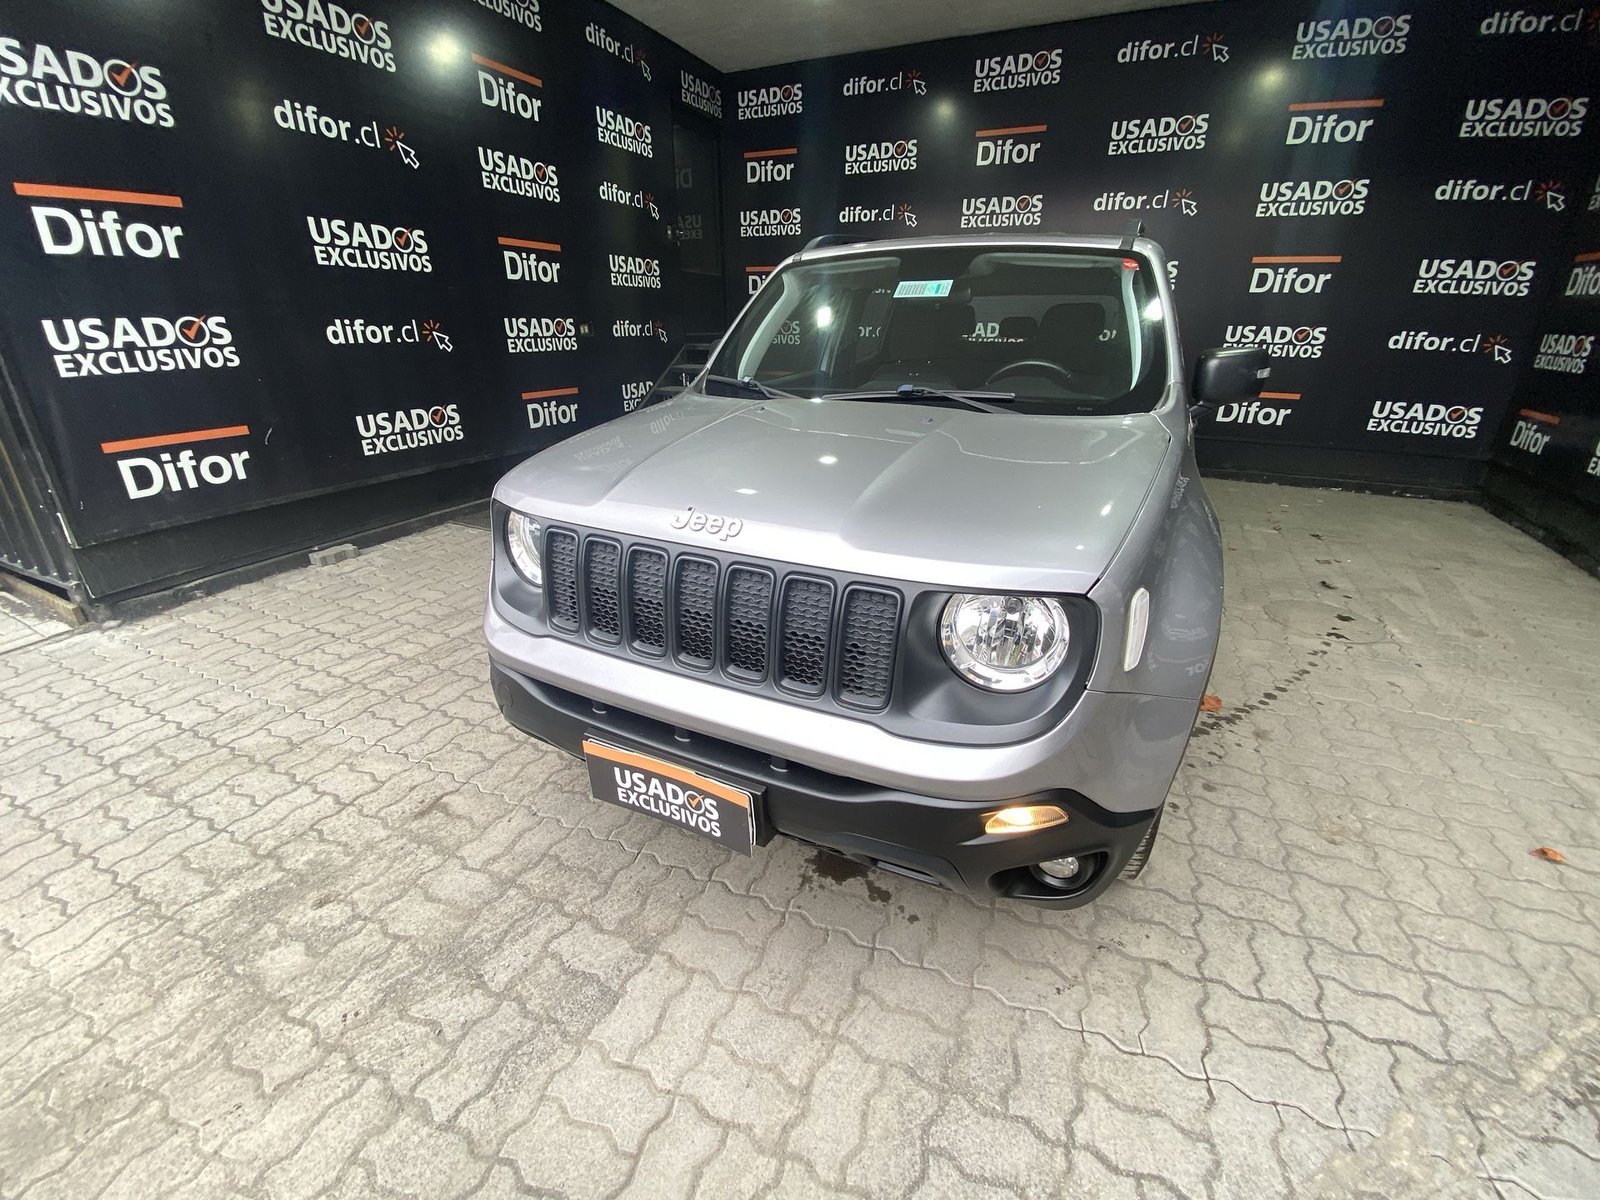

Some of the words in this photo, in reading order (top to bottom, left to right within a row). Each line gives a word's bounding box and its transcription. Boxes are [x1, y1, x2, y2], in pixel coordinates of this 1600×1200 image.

[474, 0, 542, 32] USIVOS
[1296, 14, 1411, 43] USADOS
[1480, 8, 1584, 36] difor.cl
[263, 12, 396, 73] EXCLUSIVOS
[586, 23, 634, 64] difor.cl
[1117, 35, 1199, 63] difor.cl
[1292, 38, 1407, 60] EXCLUSIVOS
[0, 36, 167, 100] SADOS
[975, 49, 1062, 78] USADOS
[681, 70, 721, 106] USADOS
[843, 71, 902, 96] difor.cl
[973, 69, 1061, 93] EXCLUSIVOS
[0, 76, 175, 128] XCLUSIVOS
[478, 70, 541, 122] Difor
[681, 90, 722, 119] EXCLUSIVOS
[737, 83, 803, 107] USADOS
[738, 101, 803, 120] EXCLUSIVOS
[1465, 97, 1590, 121] USADOS
[274, 100, 380, 149] difor.cl
[596, 106, 652, 143] USADOS
[1111, 114, 1209, 140] USADOS
[1285, 114, 1373, 145] Difor
[1459, 120, 1583, 138] EXCLUSIVOS
[598, 127, 653, 158] EXCLUSIVOS
[845, 139, 918, 162] USADOS
[976, 139, 1041, 166] Difor
[1108, 134, 1206, 156] EXCLUSIVOS
[478, 147, 558, 186] USADOS
[746, 160, 794, 183] Difor
[845, 157, 917, 175] EXCLUSIVOS
[481, 171, 560, 203] EXCLUSIVOS
[599, 182, 643, 209] difor.cl
[1260, 179, 1370, 202] USADOS
[1435, 179, 1533, 201] difor.cl
[839, 204, 895, 223] difor.cl
[962, 195, 1043, 215] USADOS
[1093, 190, 1169, 211] difor.cl
[1255, 199, 1364, 217] EXCLUSIVOS
[740, 208, 801, 226] USADOS
[740, 222, 801, 237] EXCLUSIVOS
[960, 212, 1041, 229] EXCLUSIVOS
[31, 206, 183, 259] Difor
[307, 216, 428, 254] USADOS
[314, 246, 432, 273] EXCLUSIVOS
[503, 250, 560, 283] Difor
[609, 254, 660, 276] USADOS
[1418, 259, 1536, 281] USADOS
[611, 273, 661, 289] EXCLUSIVOS
[1249, 268, 1332, 293] Difor
[1413, 279, 1530, 297] EXCLUSIVOS
[1565, 265, 1600, 295] Difo
[41, 315, 232, 352] USADOS
[326, 318, 419, 345] difor.cl
[504, 318, 576, 337] USADOS
[612, 320, 653, 338] difor.cl
[1225, 325, 1327, 345] USADOS
[507, 337, 577, 353] EXCLUSIVOS
[1388, 330, 1481, 353] difor.cl
[1540, 334, 1595, 357] USADOS
[53, 346, 240, 378] EXCLUSIVOS
[1534, 354, 1586, 374] EXCLUSIVOS
[355, 404, 460, 438] USADOS
[527, 400, 578, 429] Difor
[1216, 402, 1291, 426] Difor
[1372, 401, 1484, 424] USADOS
[361, 425, 464, 456] EXCLUSIVOS
[1367, 418, 1477, 439] EXCLUSIVOS
[1510, 421, 1550, 455] Difor
[117, 450, 250, 500] Difor
[671, 506, 743, 541] Jeep
[613, 767, 719, 821] USADOS
[617, 787, 721, 837] EXCLUSIVOS
